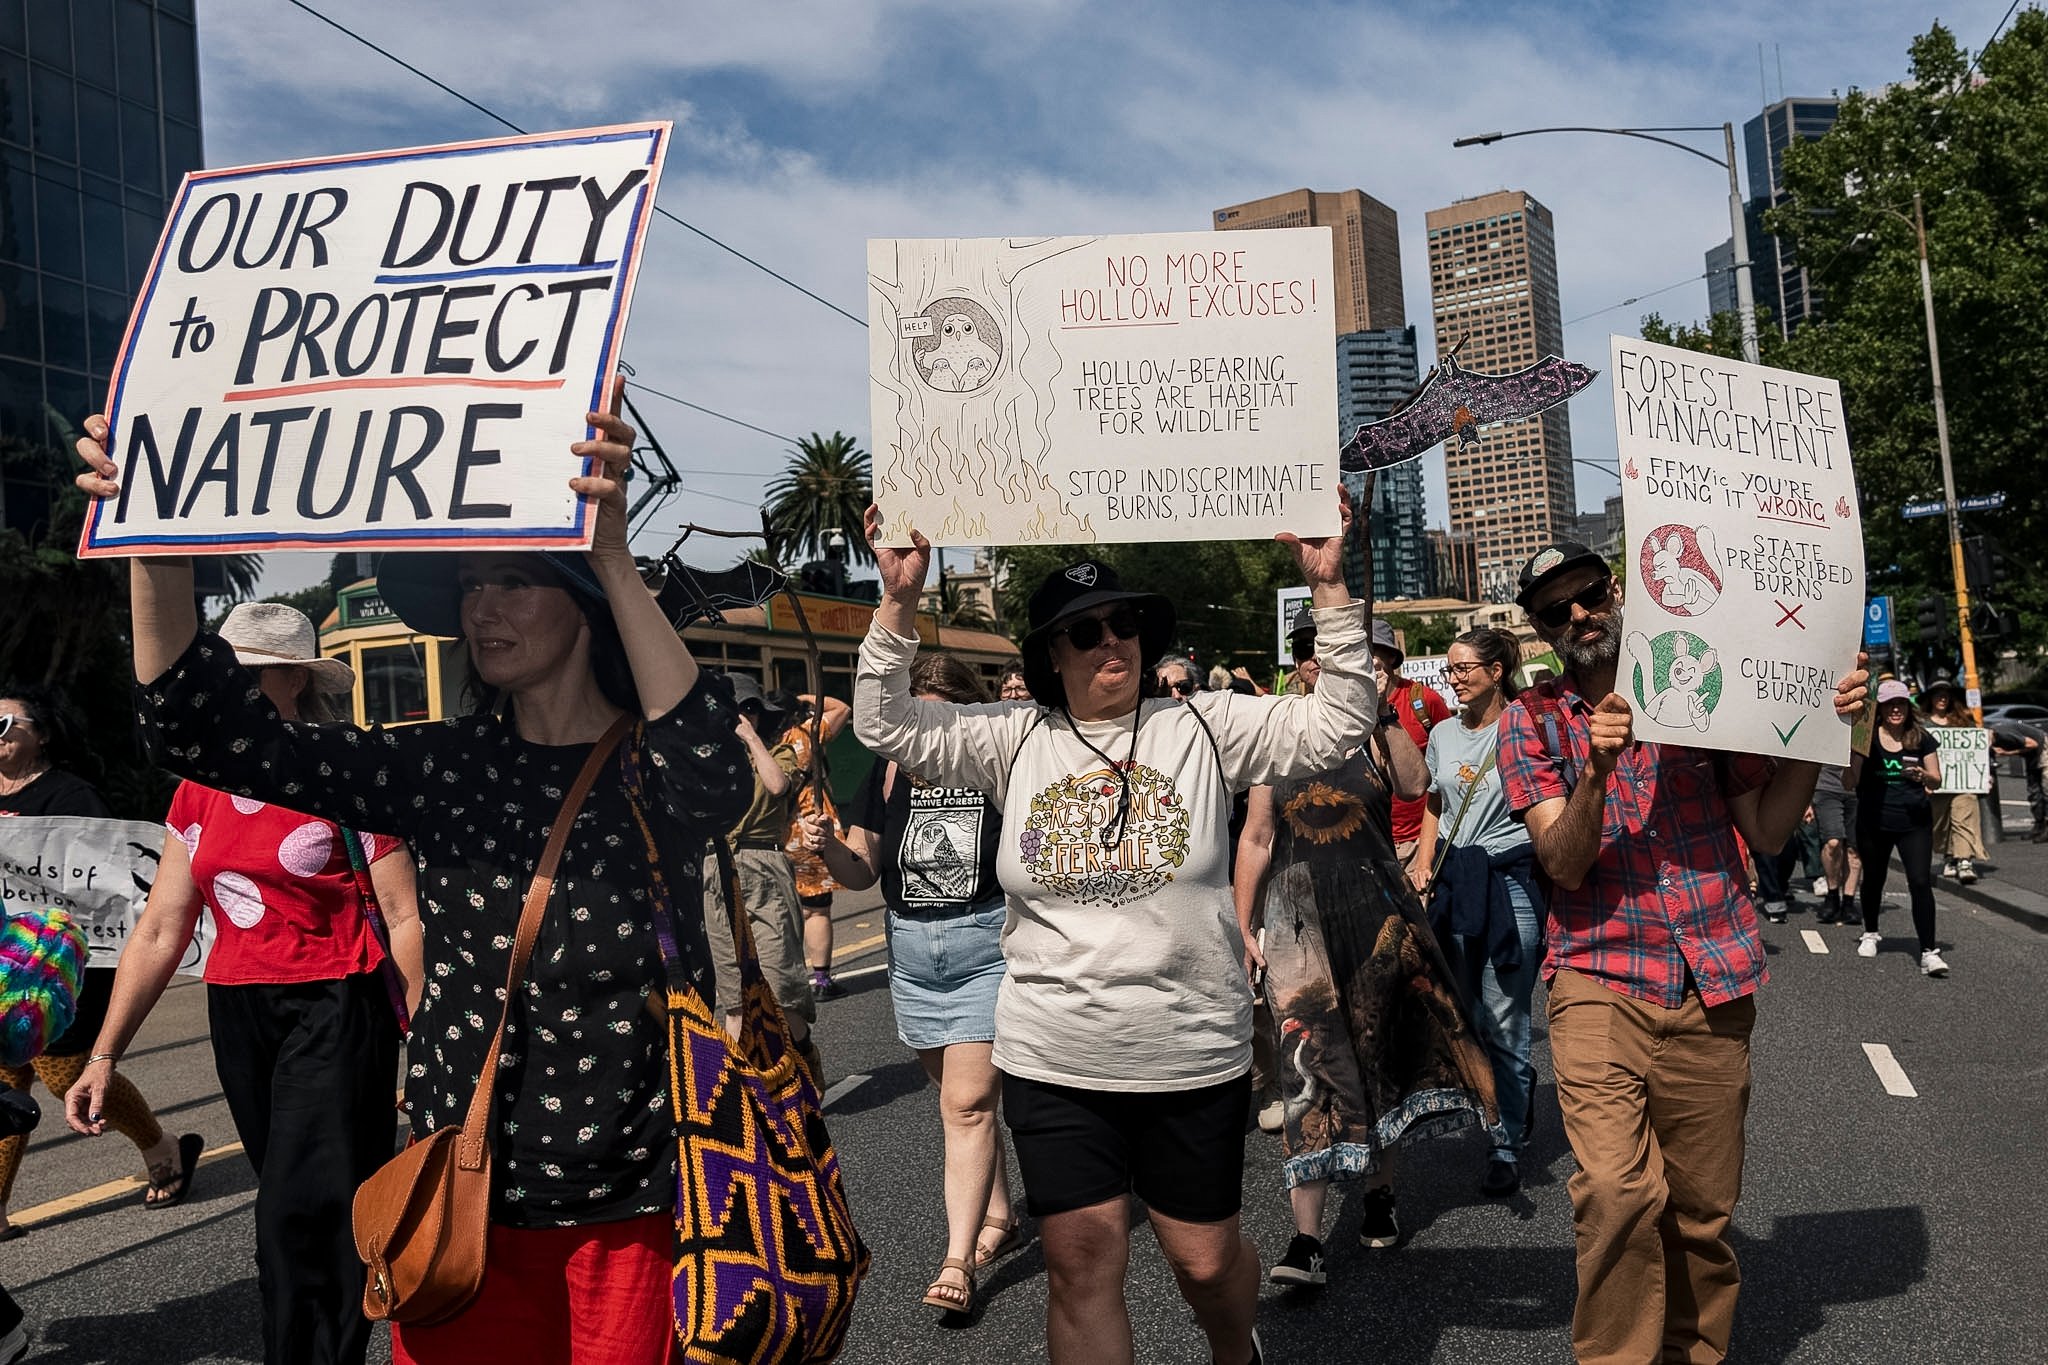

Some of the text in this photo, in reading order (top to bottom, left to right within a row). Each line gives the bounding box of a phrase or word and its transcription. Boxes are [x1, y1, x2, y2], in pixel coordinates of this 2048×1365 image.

[178, 169, 648, 274] OUR DUTY
[1107, 250, 1247, 288] NO MORE
[1061, 279, 1317, 322] HOLLOW EXCUSES!
[169, 276, 612, 385] to PROTECT
[905, 322, 928, 332] HELP
[1082, 356, 1285, 386] HOLLOW-BEARING
[1073, 382, 1298, 411] TREES ARE HABITAT
[1620, 350, 1836, 430] FOREST FIRE
[1099, 408, 1260, 435] FOR WILDLIFE
[1626, 391, 1834, 470] MANAGEMENT
[115, 403, 523, 524] NATURE
[1650, 457, 1814, 501] FFMVic YOU'RE
[1068, 464, 1324, 496] STOP INDISCRIMINATE
[1107, 491, 1284, 521] BURNS, JACINTA!
[1647, 476, 1825, 522] DOING IT WRONG
[1753, 534, 1823, 562] STATE
[1726, 548, 1852, 585] PRESCRIBED
[1755, 572, 1823, 601] BURNS
[1740, 658, 1839, 691] CULTURAL
[1757, 681, 1822, 708] BURNS
[1930, 729, 1987, 750] ORESTS
[1943, 760, 1986, 790] MILY
[910, 797, 985, 807] NATIVE FORESTS
[1056, 838, 1154, 873] FERTILE
[3, 855, 97, 890] ends of
[80, 920, 128, 939] rest
